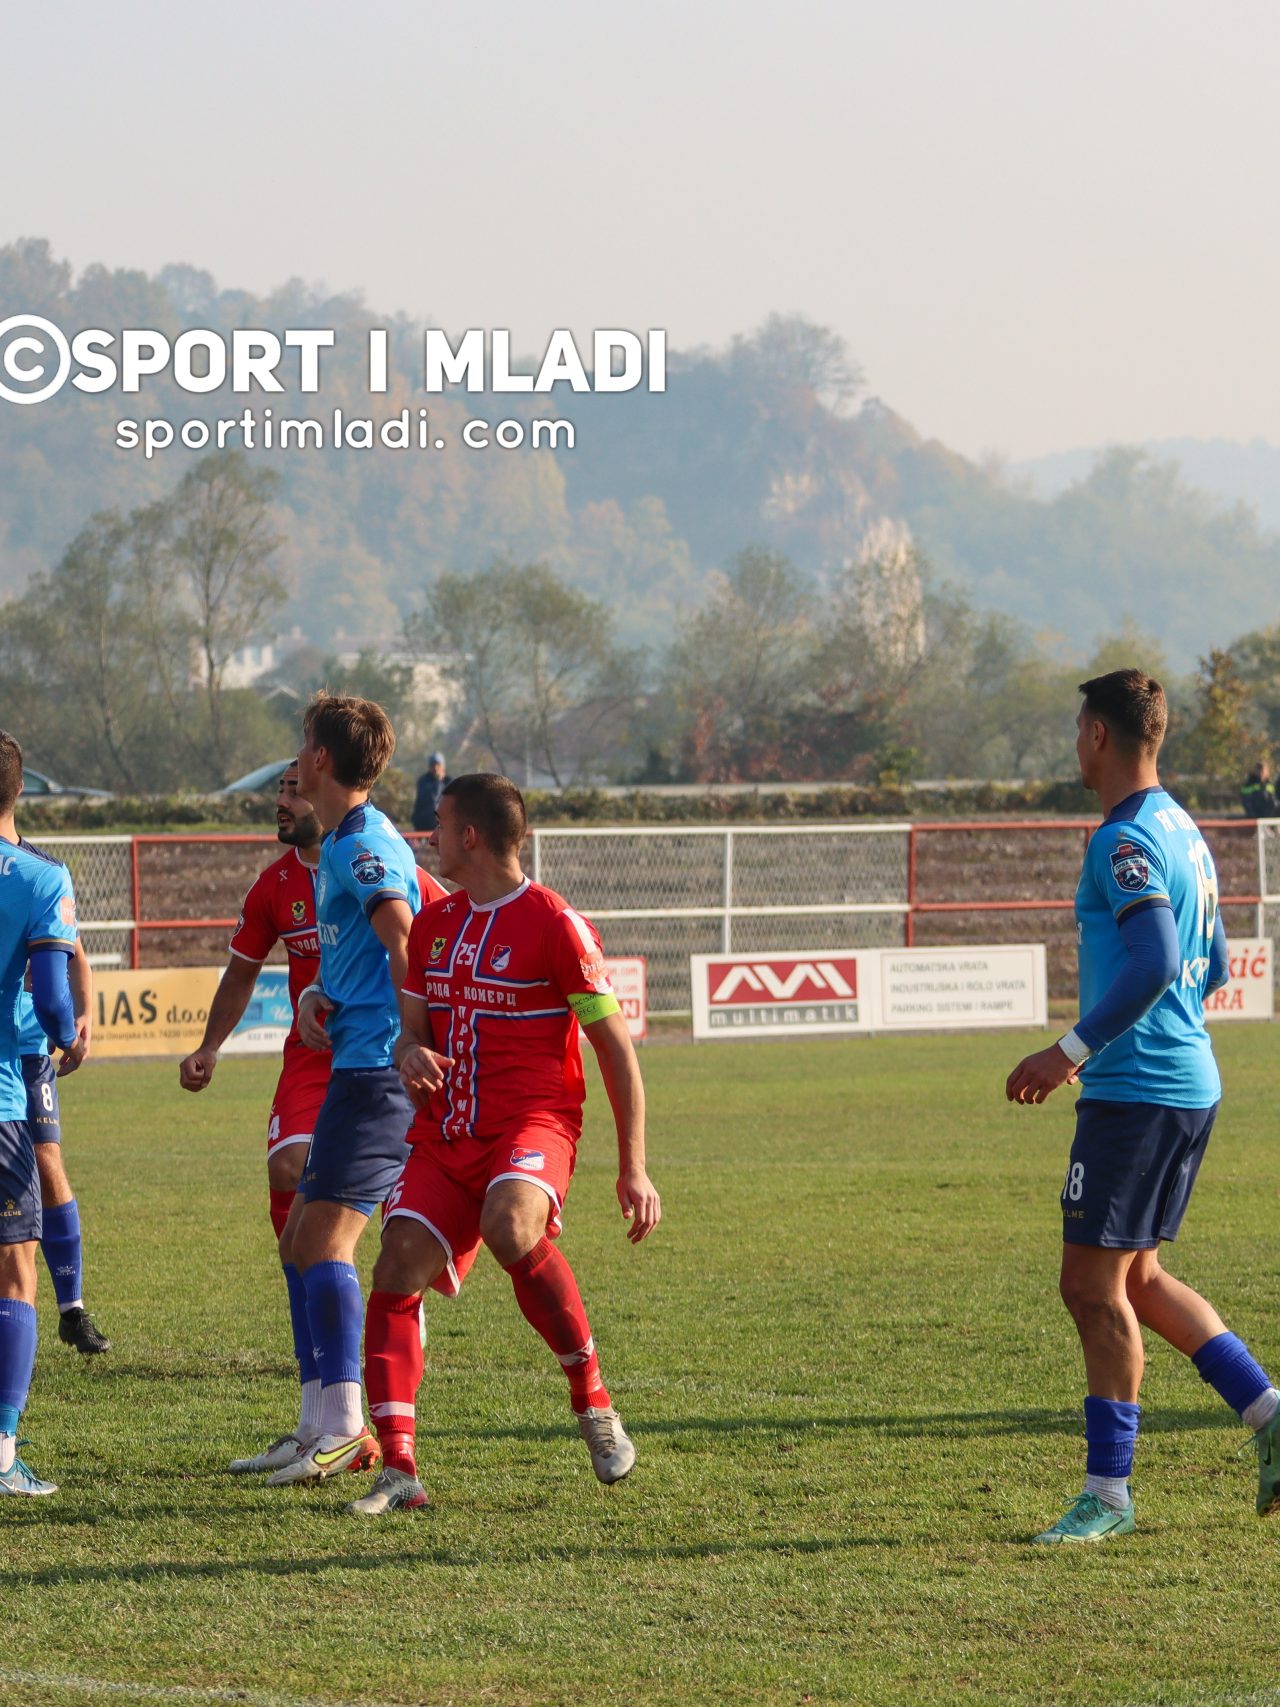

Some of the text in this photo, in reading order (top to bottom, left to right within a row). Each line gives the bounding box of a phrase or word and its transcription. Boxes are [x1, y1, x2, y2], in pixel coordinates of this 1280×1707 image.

[456, 942, 477, 966] 25
[890, 960, 988, 973] AUTOMATSKA VRATA
[995, 979, 1027, 990] VRATA
[464, 986, 516, 1007] КОМЕРЦ
[711, 1005, 857, 1026] multimatik
[891, 1002, 932, 1013] PARKING
[41, 1082, 54, 1112] 8
